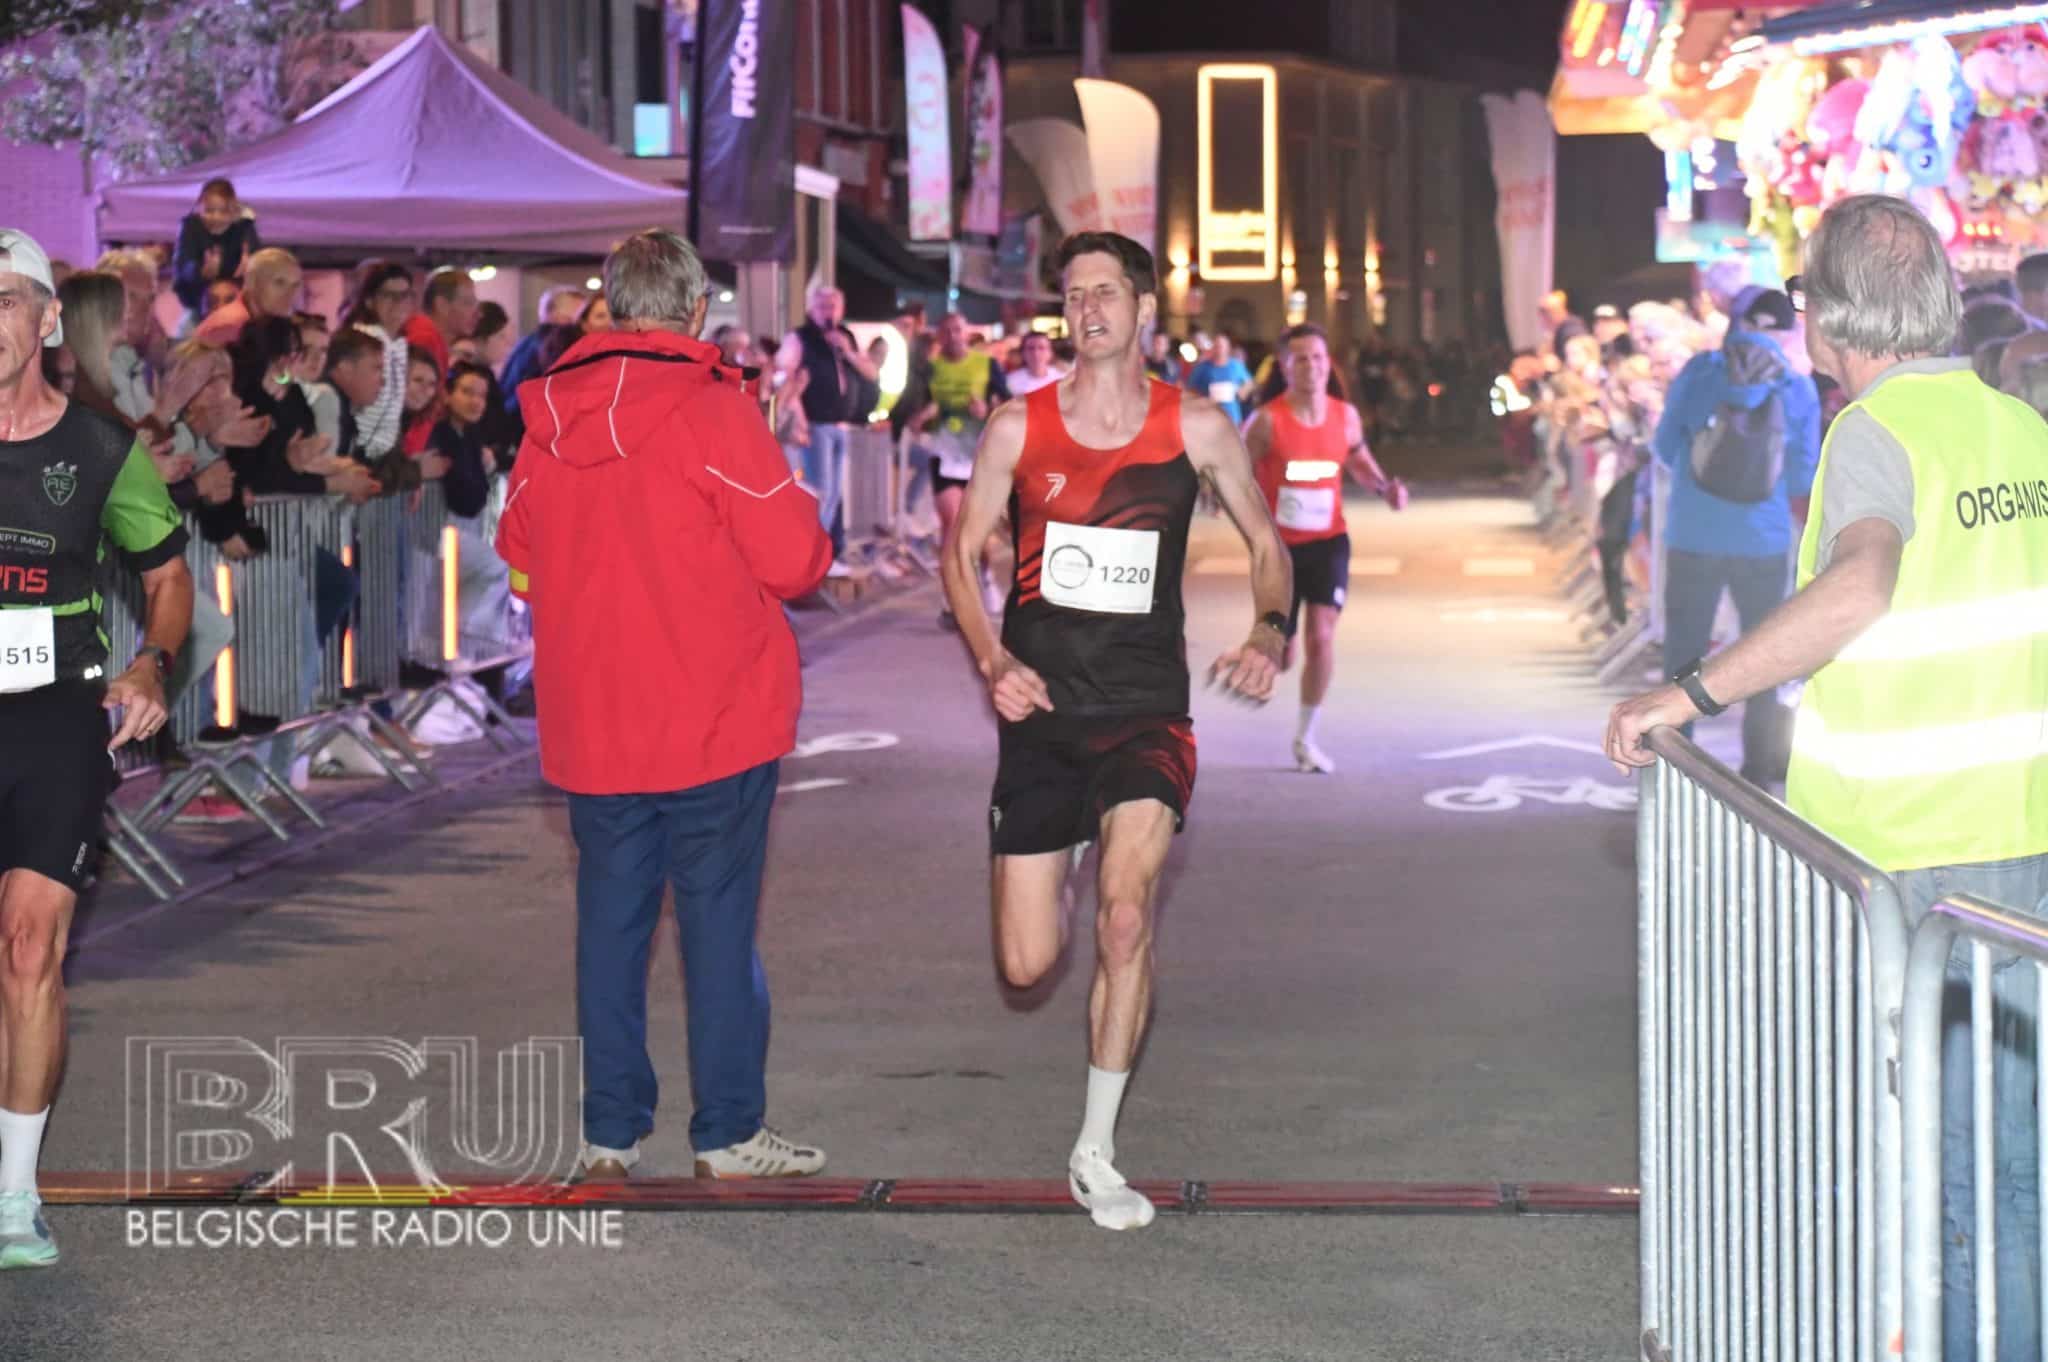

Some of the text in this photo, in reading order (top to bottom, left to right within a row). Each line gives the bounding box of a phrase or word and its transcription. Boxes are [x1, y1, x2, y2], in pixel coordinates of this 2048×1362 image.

[1956, 480, 2048, 529] ORGANIS
[0, 565, 48, 592] ns
[1100, 566, 1151, 584] 1220
